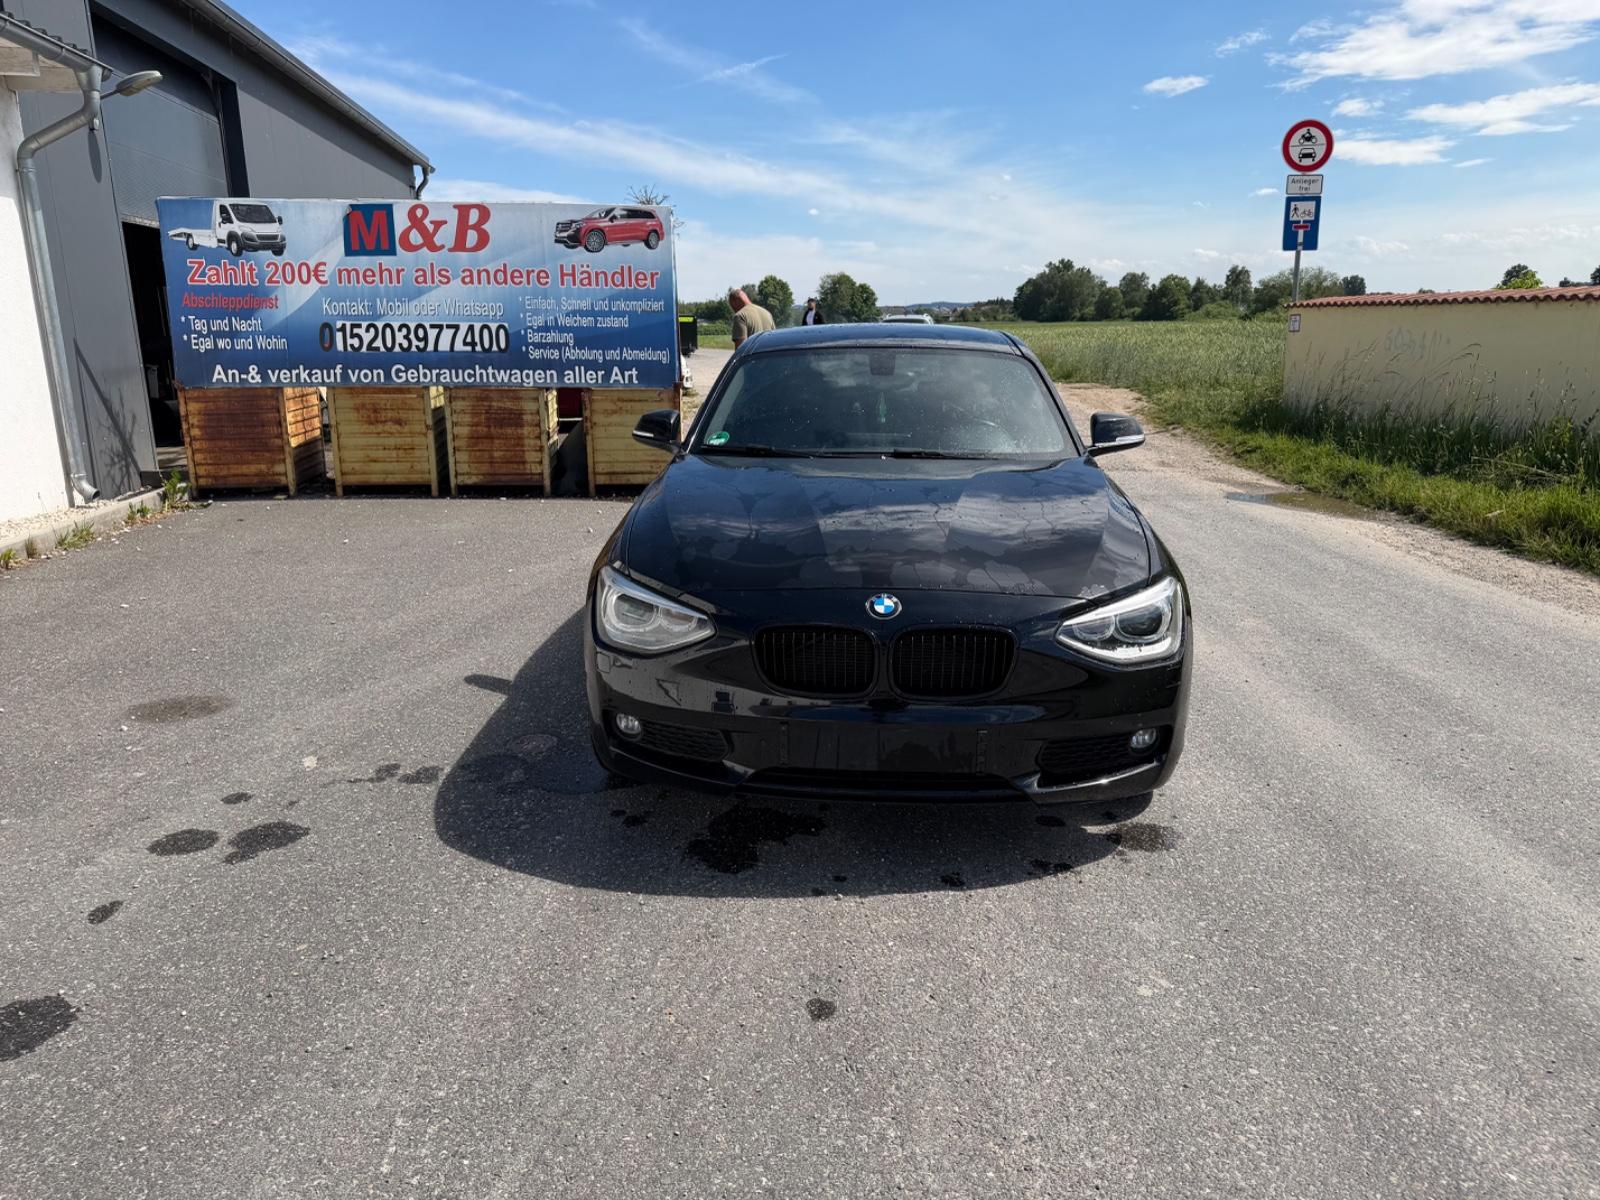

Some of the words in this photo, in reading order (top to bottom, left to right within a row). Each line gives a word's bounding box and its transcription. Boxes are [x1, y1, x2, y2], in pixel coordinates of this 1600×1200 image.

[187, 258, 259, 286] Zahlt
[265, 260, 329, 286] 200€
[336, 261, 405, 286] mehr
[413, 261, 452, 287] als
[460, 262, 551, 287] andere
[559, 263, 660, 289] Händler
[182, 292, 279, 311] Abschleppdienst
[322, 297, 373, 316] Kontakt:
[376, 298, 410, 316] Mobil
[414, 298, 441, 317] oder
[444, 299, 504, 320] Whatsapp
[525, 296, 559, 311] Einfach,
[561, 297, 592, 311] Schnell
[594, 297, 609, 311] und
[611, 298, 665, 314] unkompliziert
[188, 316, 207, 334] Tag
[210, 316, 229, 331] und
[232, 316, 262, 332] Nacht
[526, 312, 545, 329] Egal
[547, 313, 555, 327] in
[556, 313, 595, 327] Welchem
[597, 314, 629, 328] zustand
[191, 334, 214, 352] Egal
[216, 338, 231, 350] wo
[234, 335, 253, 350] und
[255, 335, 288, 350] Wohin
[319, 321, 510, 353] 015203977400
[527, 329, 574, 345] Barzahlung
[528, 346, 560, 360] Service
[561, 346, 603, 363] (Abholung
[605, 347, 620, 361] und
[622, 347, 670, 364] Abmeldung)
[212, 364, 262, 384] An-&
[267, 364, 342, 384] verkauf
[347, 367, 385, 383] von
[390, 364, 558, 387] Gebrauchtwagen
[563, 365, 605, 384] aller
[609, 365, 639, 384] Art
